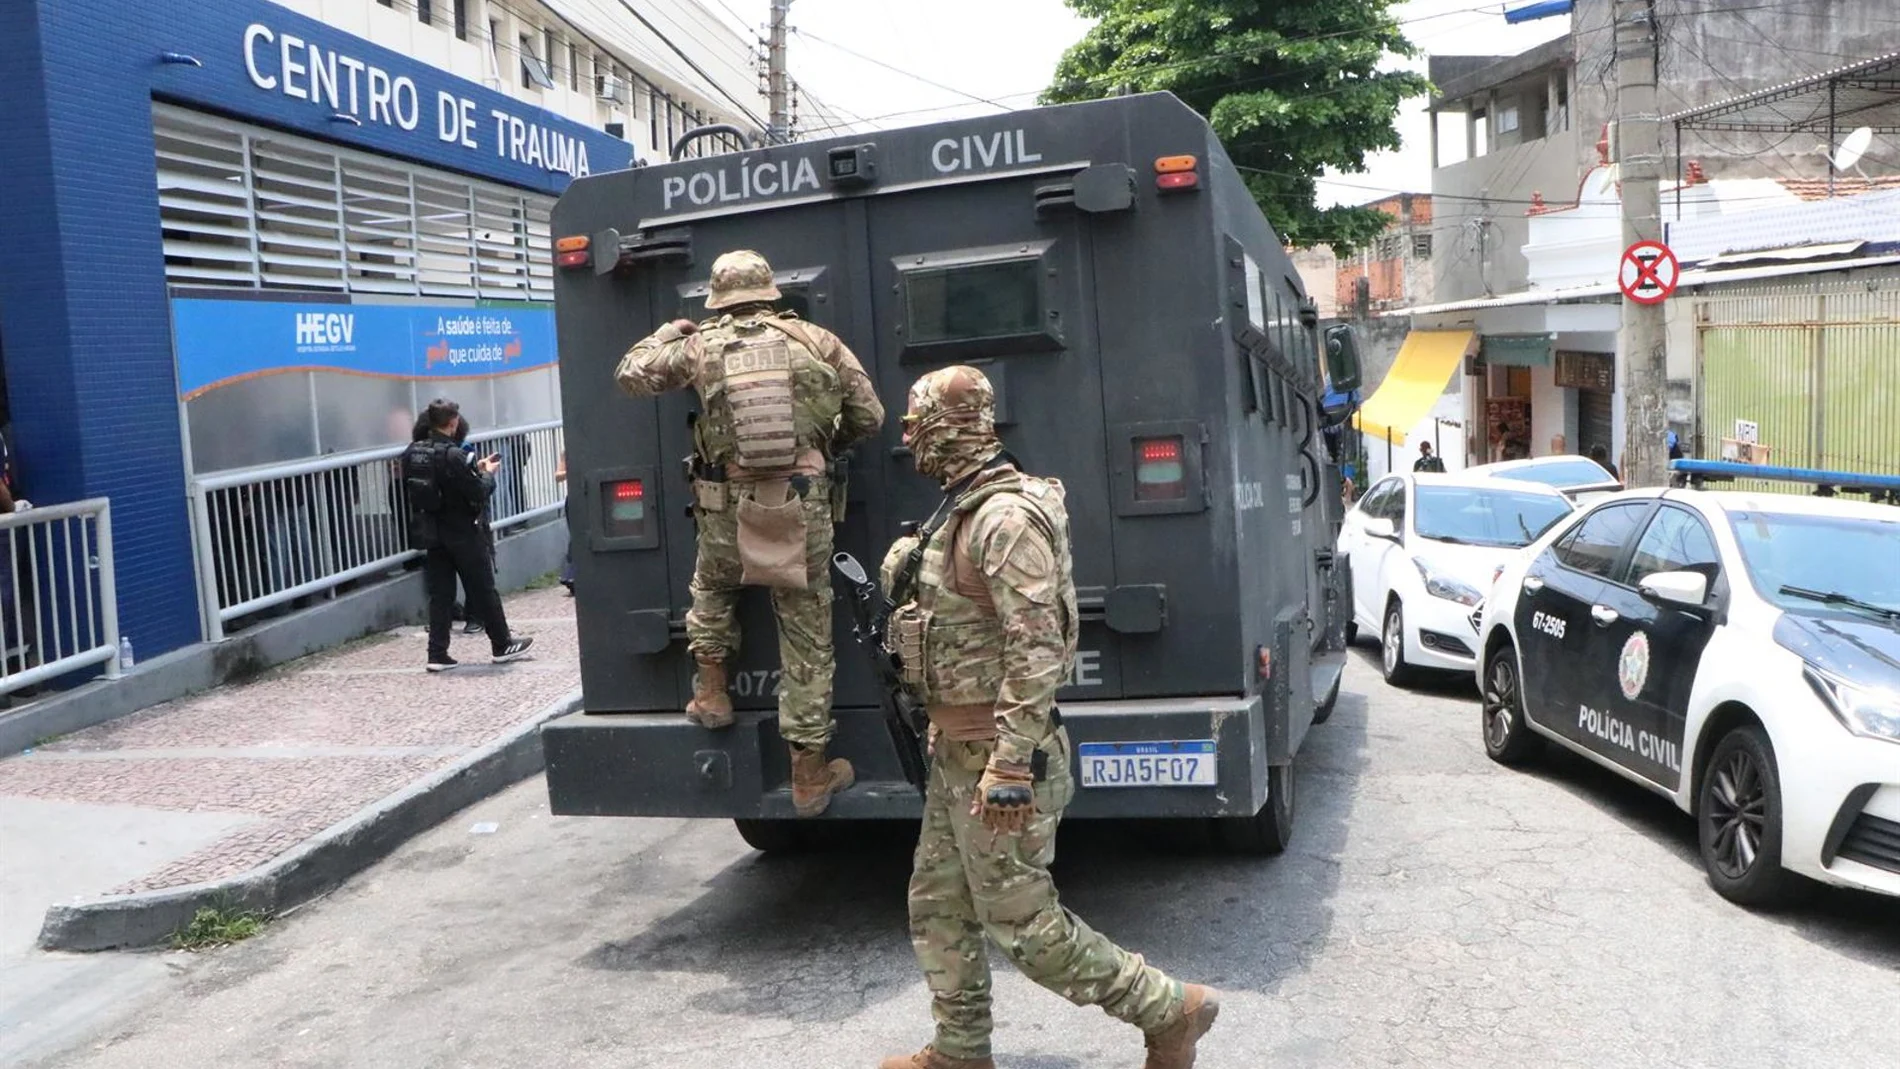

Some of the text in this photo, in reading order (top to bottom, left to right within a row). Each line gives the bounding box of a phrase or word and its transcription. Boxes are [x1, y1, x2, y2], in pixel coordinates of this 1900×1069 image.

[244, 24, 590, 177] CENTRO DE TRAUMA
[663, 128, 1042, 210] POLÍCIA CIVIL
[296, 313, 354, 344] HEGV
[437, 315, 445, 335] A
[446, 315, 475, 335] saúde
[476, 317, 482, 334] é
[502, 317, 512, 335] de
[449, 348, 467, 367] que
[468, 343, 492, 363] cuida
[492, 343, 503, 361] de
[1532, 611, 1567, 639] 67-2505
[1579, 704, 1681, 773] POLÍCIA CIVIL
[1093, 758, 1199, 783] RJA5F07
